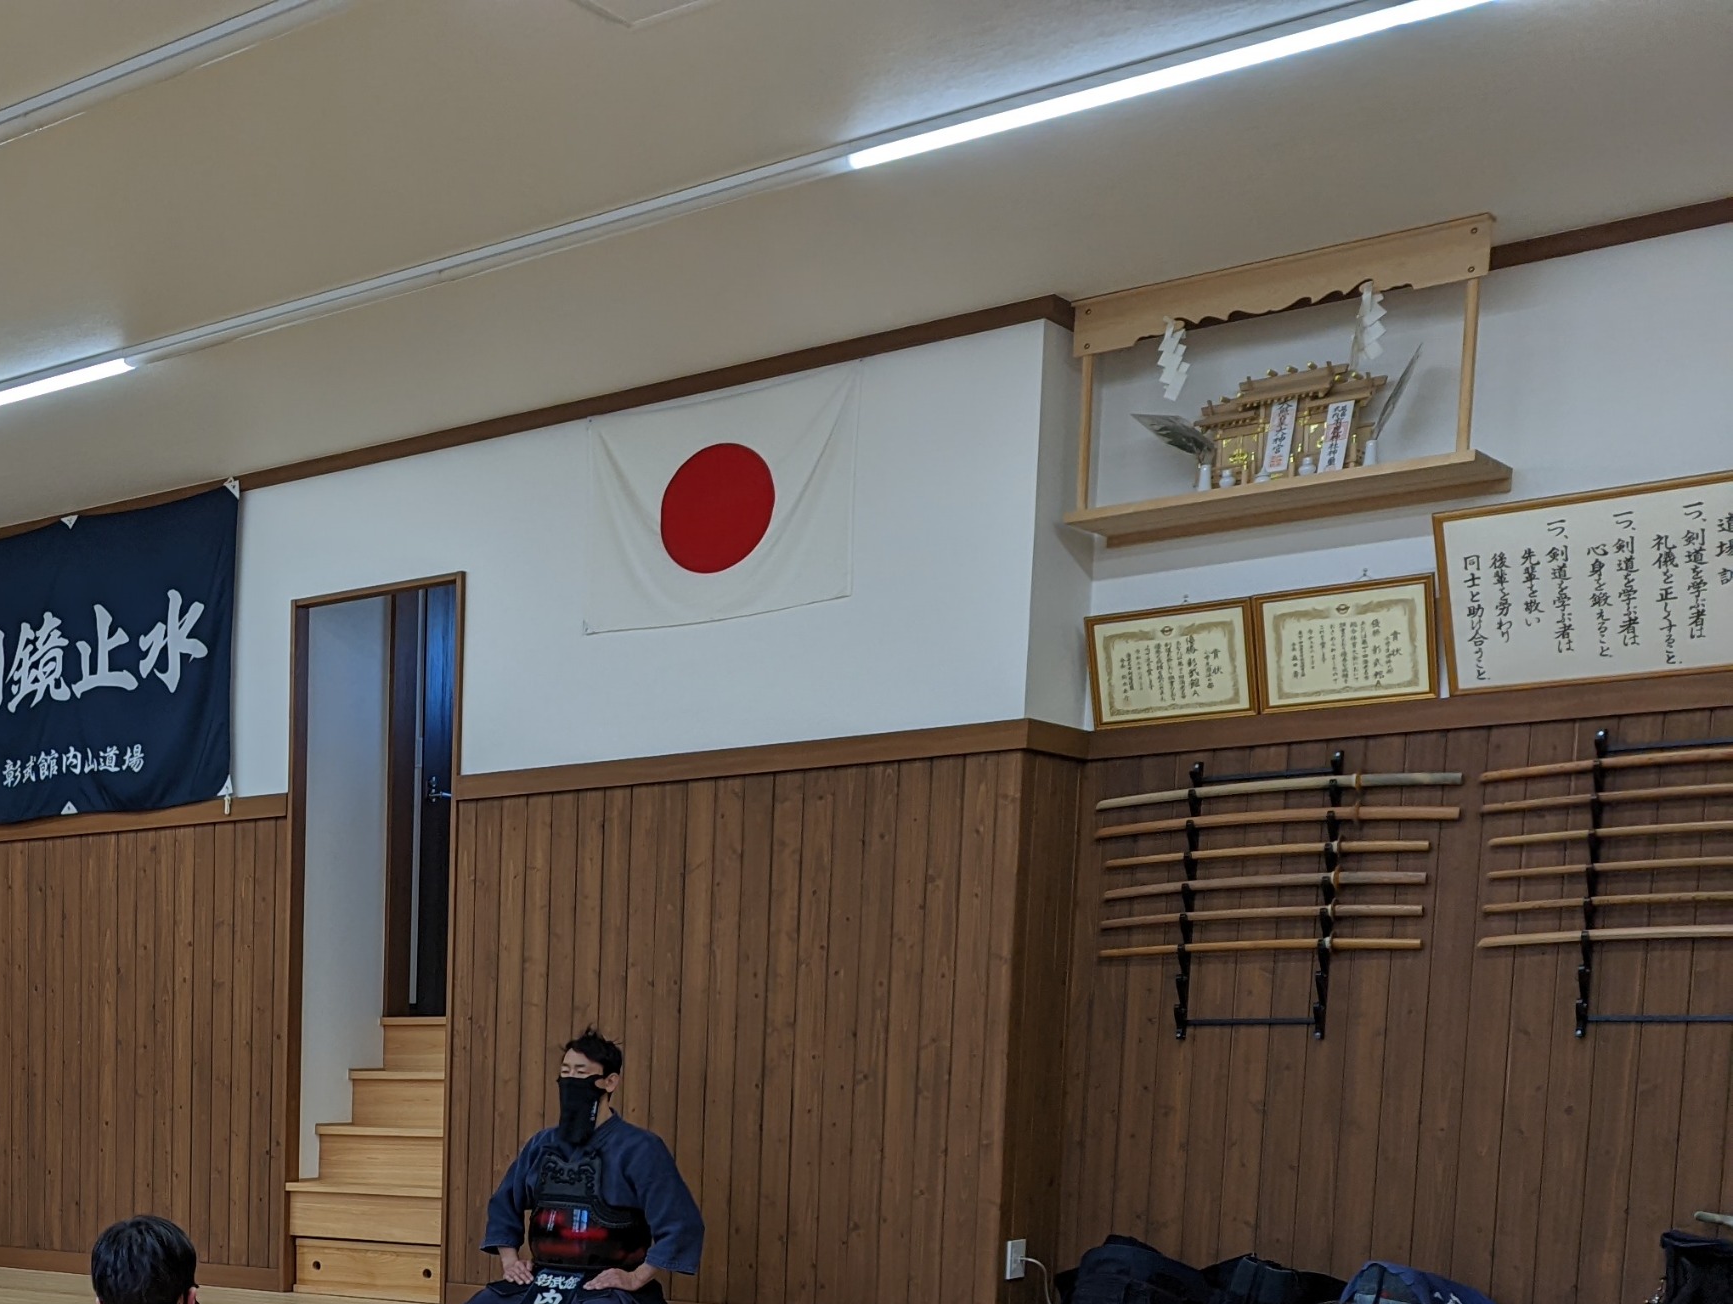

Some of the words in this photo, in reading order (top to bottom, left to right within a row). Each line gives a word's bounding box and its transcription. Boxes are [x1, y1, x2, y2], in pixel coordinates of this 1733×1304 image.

[1520, 548, 1545, 627] 先輩を敬い
[2, 743, 145, 788] 彰武館内山道場
